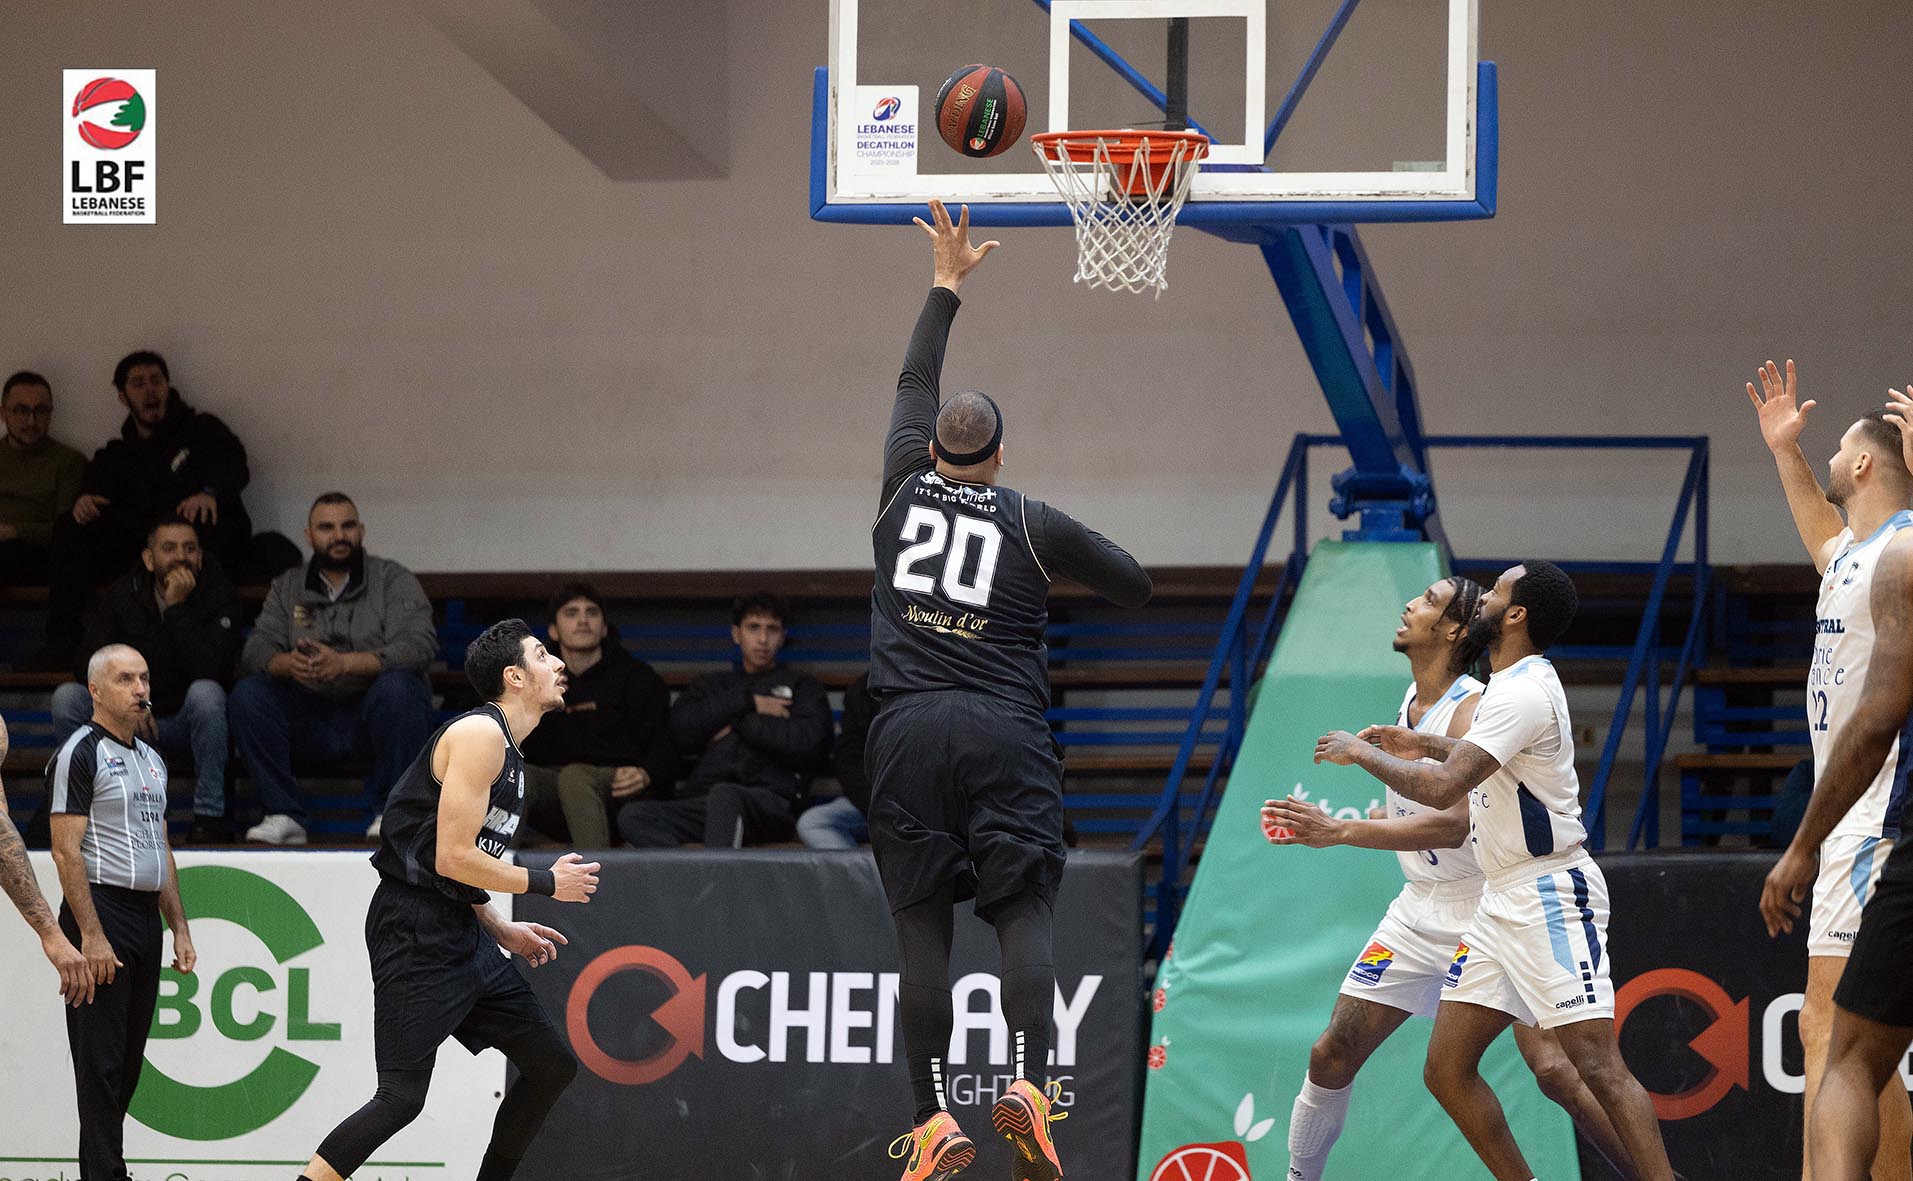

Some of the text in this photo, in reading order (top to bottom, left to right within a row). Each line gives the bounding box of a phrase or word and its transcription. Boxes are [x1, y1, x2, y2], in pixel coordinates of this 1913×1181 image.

[977, 97, 994, 138] LEBANESE
[857, 124, 915, 134] LEBANESE
[857, 141, 915, 149] DECATHLON
[914, 486, 932, 497] IT'S
[932, 491, 940, 499] A
[942, 494, 957, 503] BIG
[893, 504, 1003, 608] 20
[901, 605, 989, 631] Moulin d'or
[1827, 930, 1859, 941] capell
[147, 966, 341, 1041] BCL
[1555, 994, 1585, 1009] capelli
[715, 969, 1103, 1067] CHEAY
